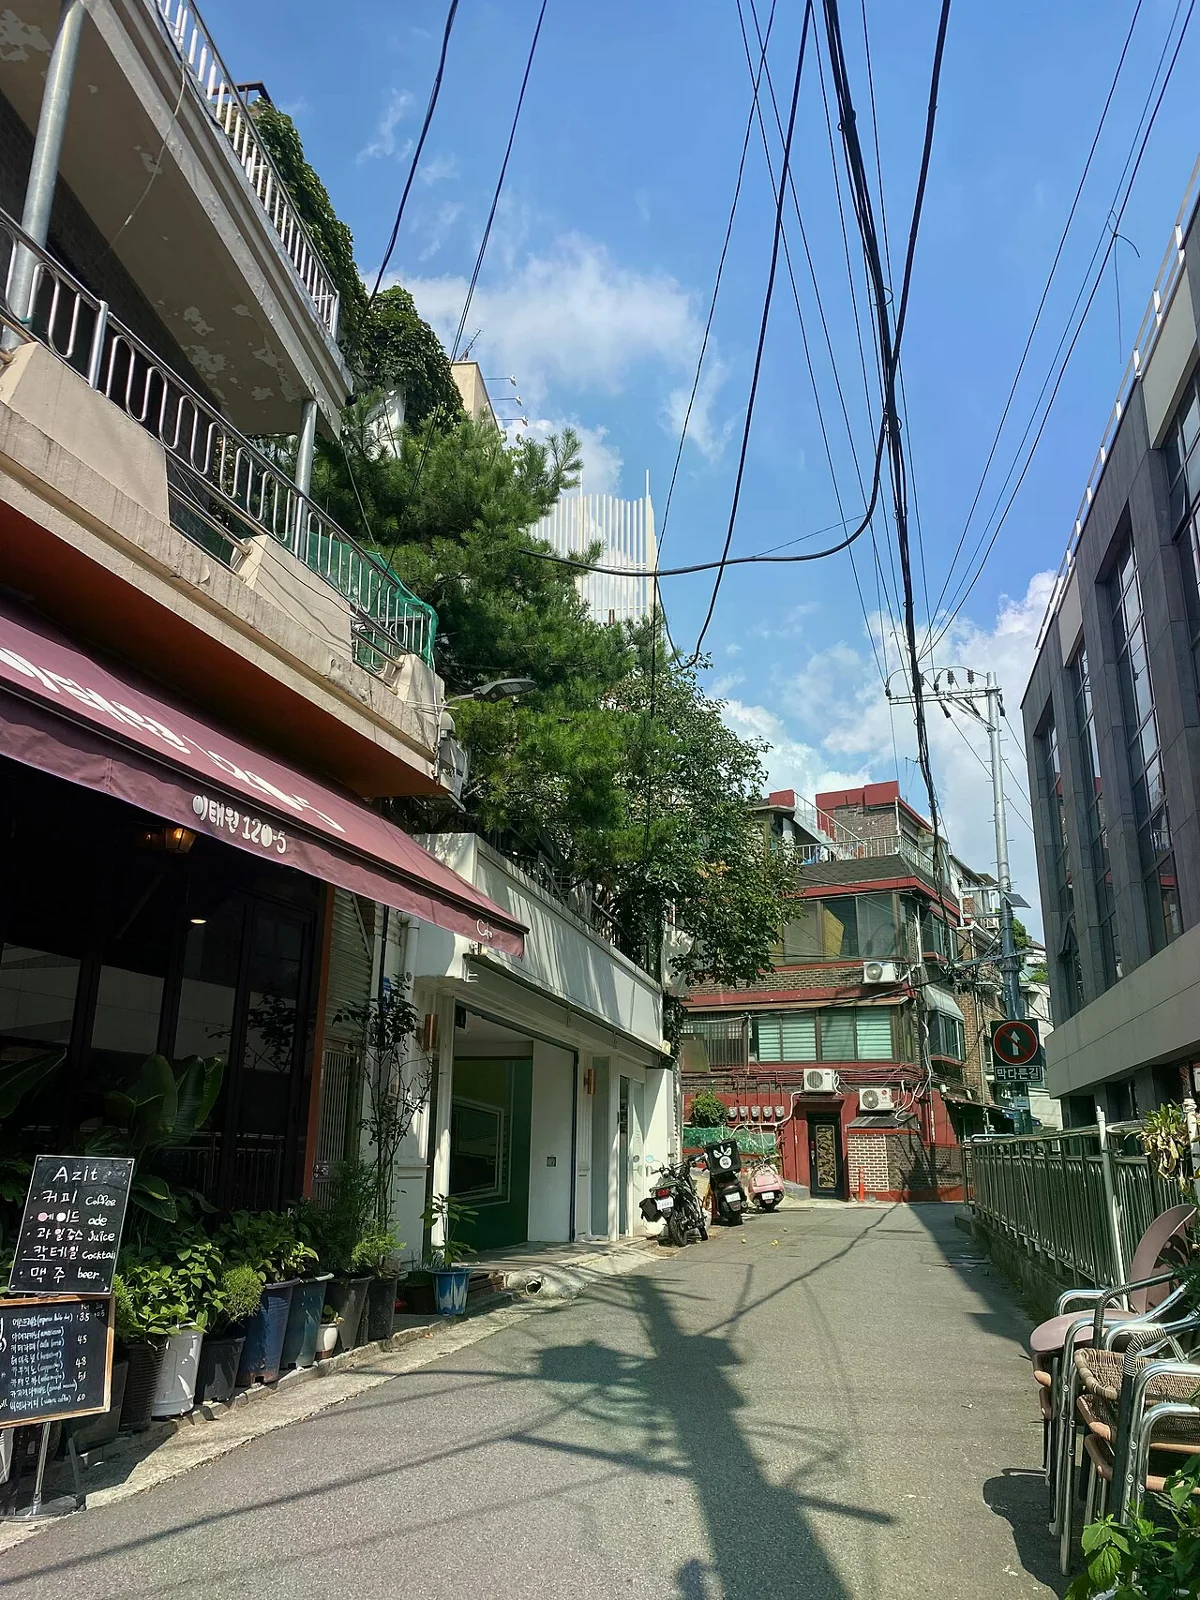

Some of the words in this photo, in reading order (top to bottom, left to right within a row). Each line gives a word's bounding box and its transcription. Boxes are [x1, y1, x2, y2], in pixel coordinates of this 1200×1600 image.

[193, 795, 239, 833] 이태원
[242, 816, 287, 853] 120-5
[996, 1067, 1039, 1080] 막다른길
[52, 1166, 98, 1182] Azit
[42, 1190, 78, 1204] 커피
[37, 1209, 80, 1222] 에이드
[88, 1213, 108, 1226] ade
[33, 1245, 79, 1260] 칵테일
